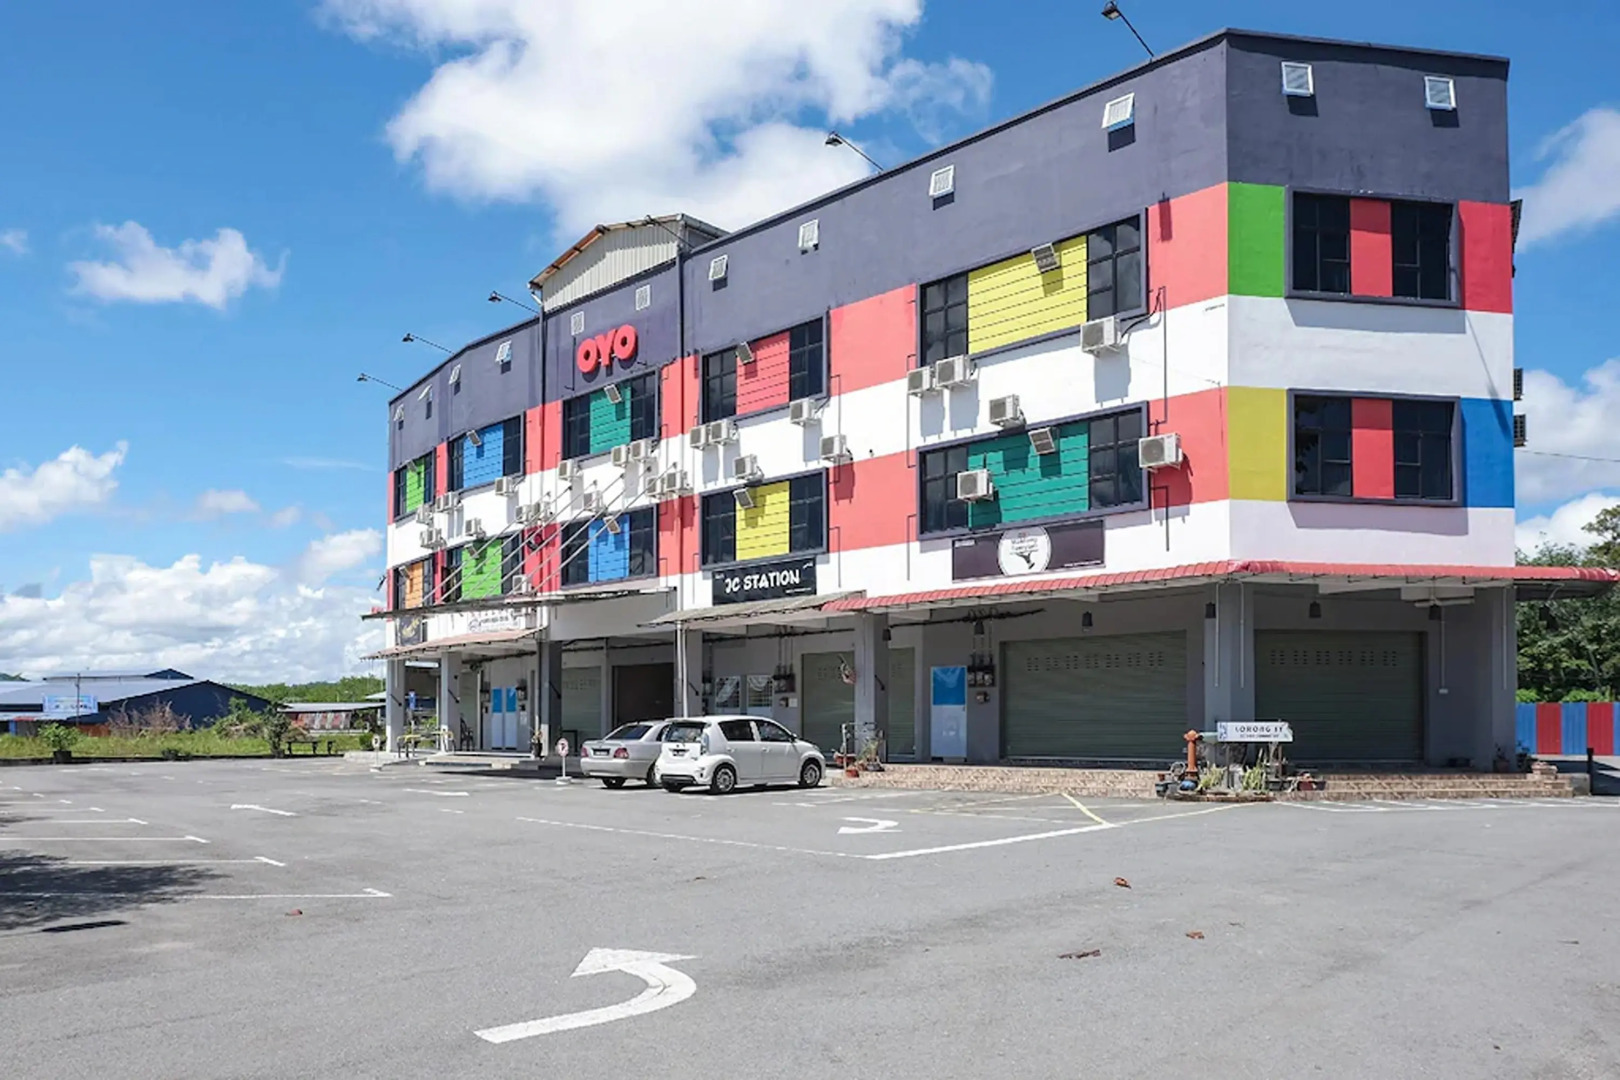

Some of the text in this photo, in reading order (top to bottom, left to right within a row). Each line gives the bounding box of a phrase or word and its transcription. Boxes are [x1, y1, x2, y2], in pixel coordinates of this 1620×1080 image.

[577, 324, 638, 374] OYO
[724, 577, 740, 594] JC
[743, 569, 800, 590] STATION
